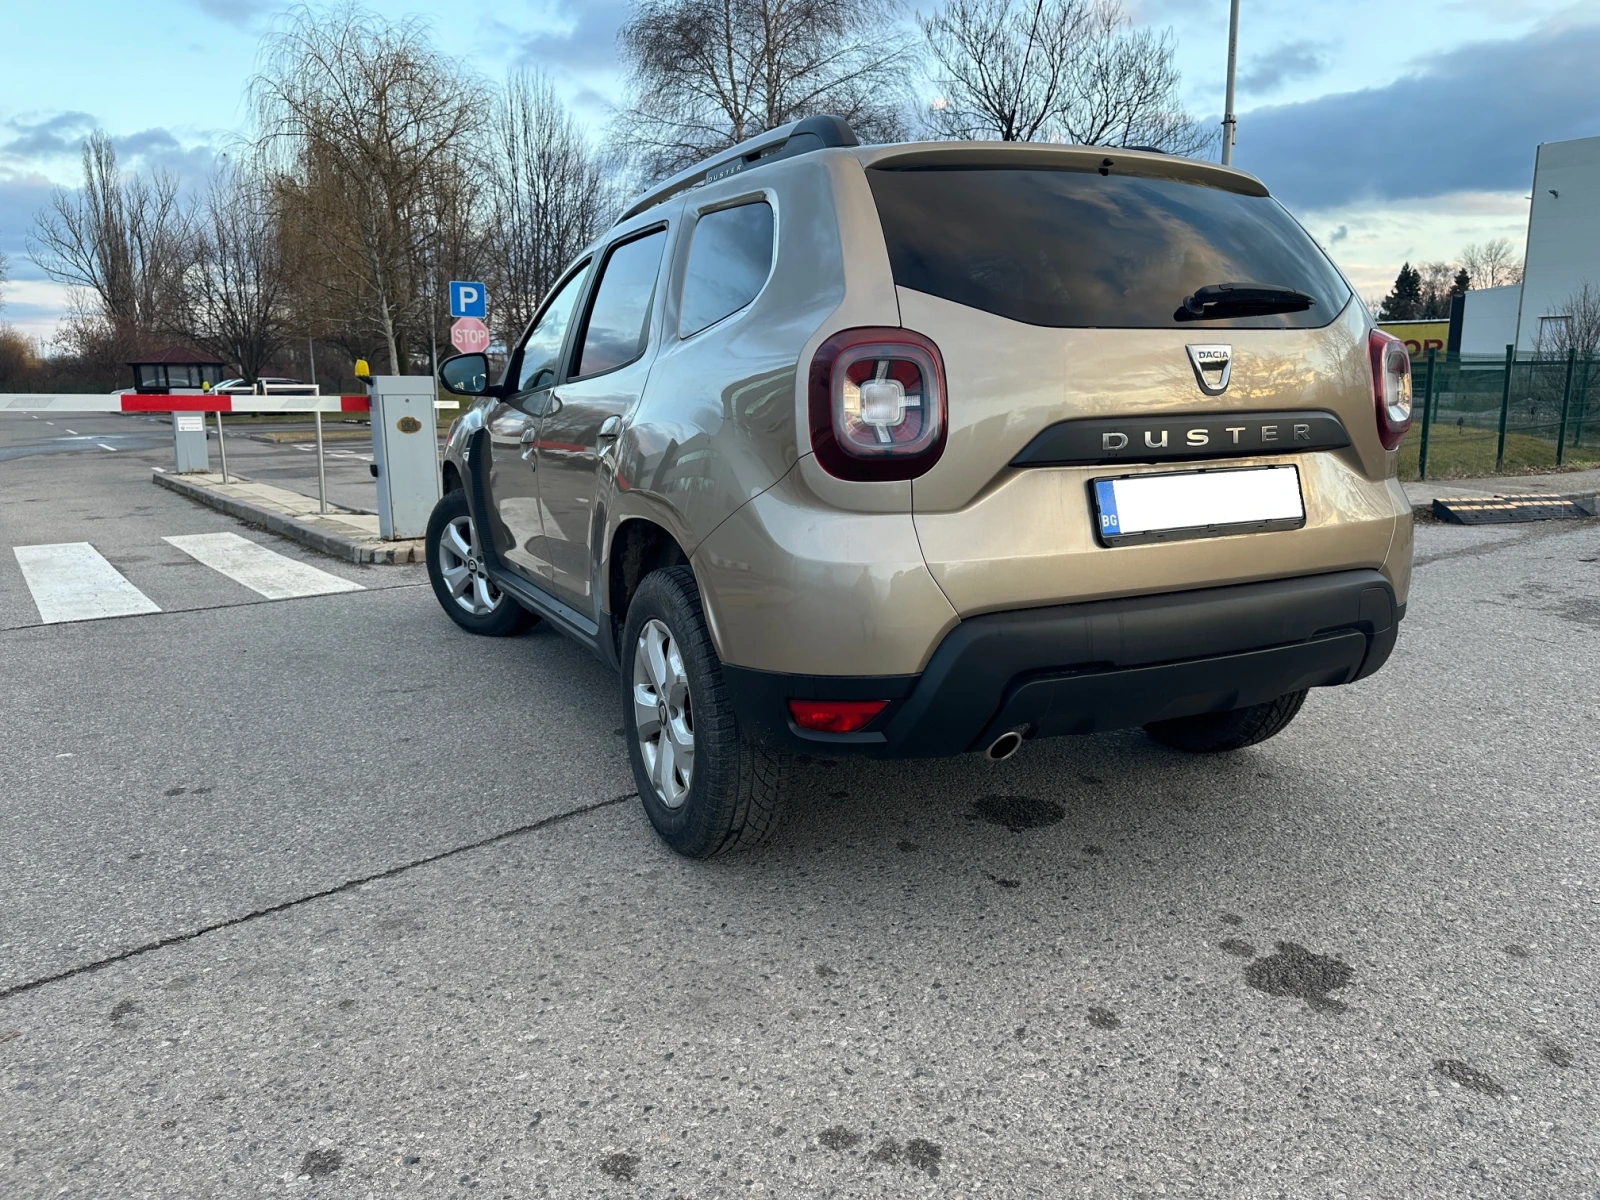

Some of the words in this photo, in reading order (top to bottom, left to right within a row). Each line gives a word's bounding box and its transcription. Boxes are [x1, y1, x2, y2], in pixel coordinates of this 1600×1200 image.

[708, 164, 742, 182] DUSTER
[459, 286, 478, 312] P
[455, 329, 485, 344] STOP
[1102, 423, 1310, 450] DUSTER
[1101, 514, 1117, 527] BG
